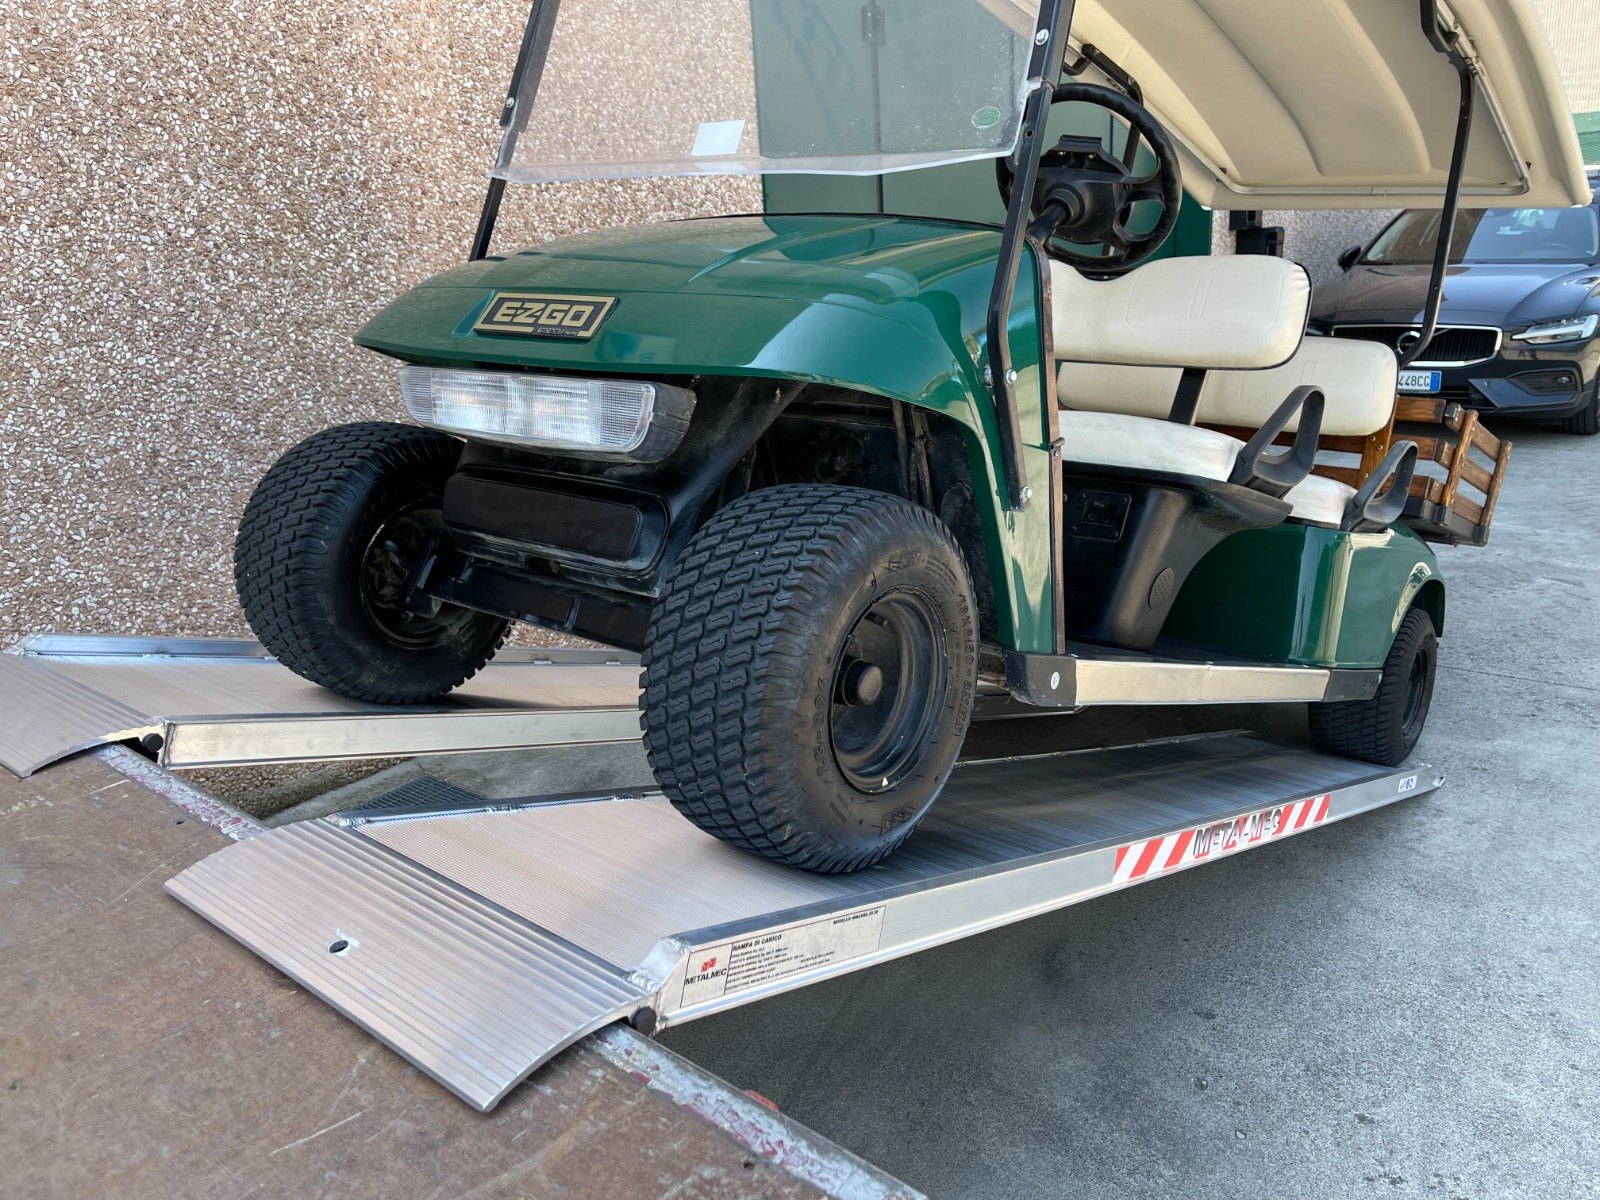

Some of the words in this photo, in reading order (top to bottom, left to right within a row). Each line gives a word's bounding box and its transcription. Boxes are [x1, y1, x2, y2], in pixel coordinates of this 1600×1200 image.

[1193, 808, 1282, 856] METALMEC
[761, 934, 782, 945] CARICO
[684, 968, 728, 986] METALMEC
